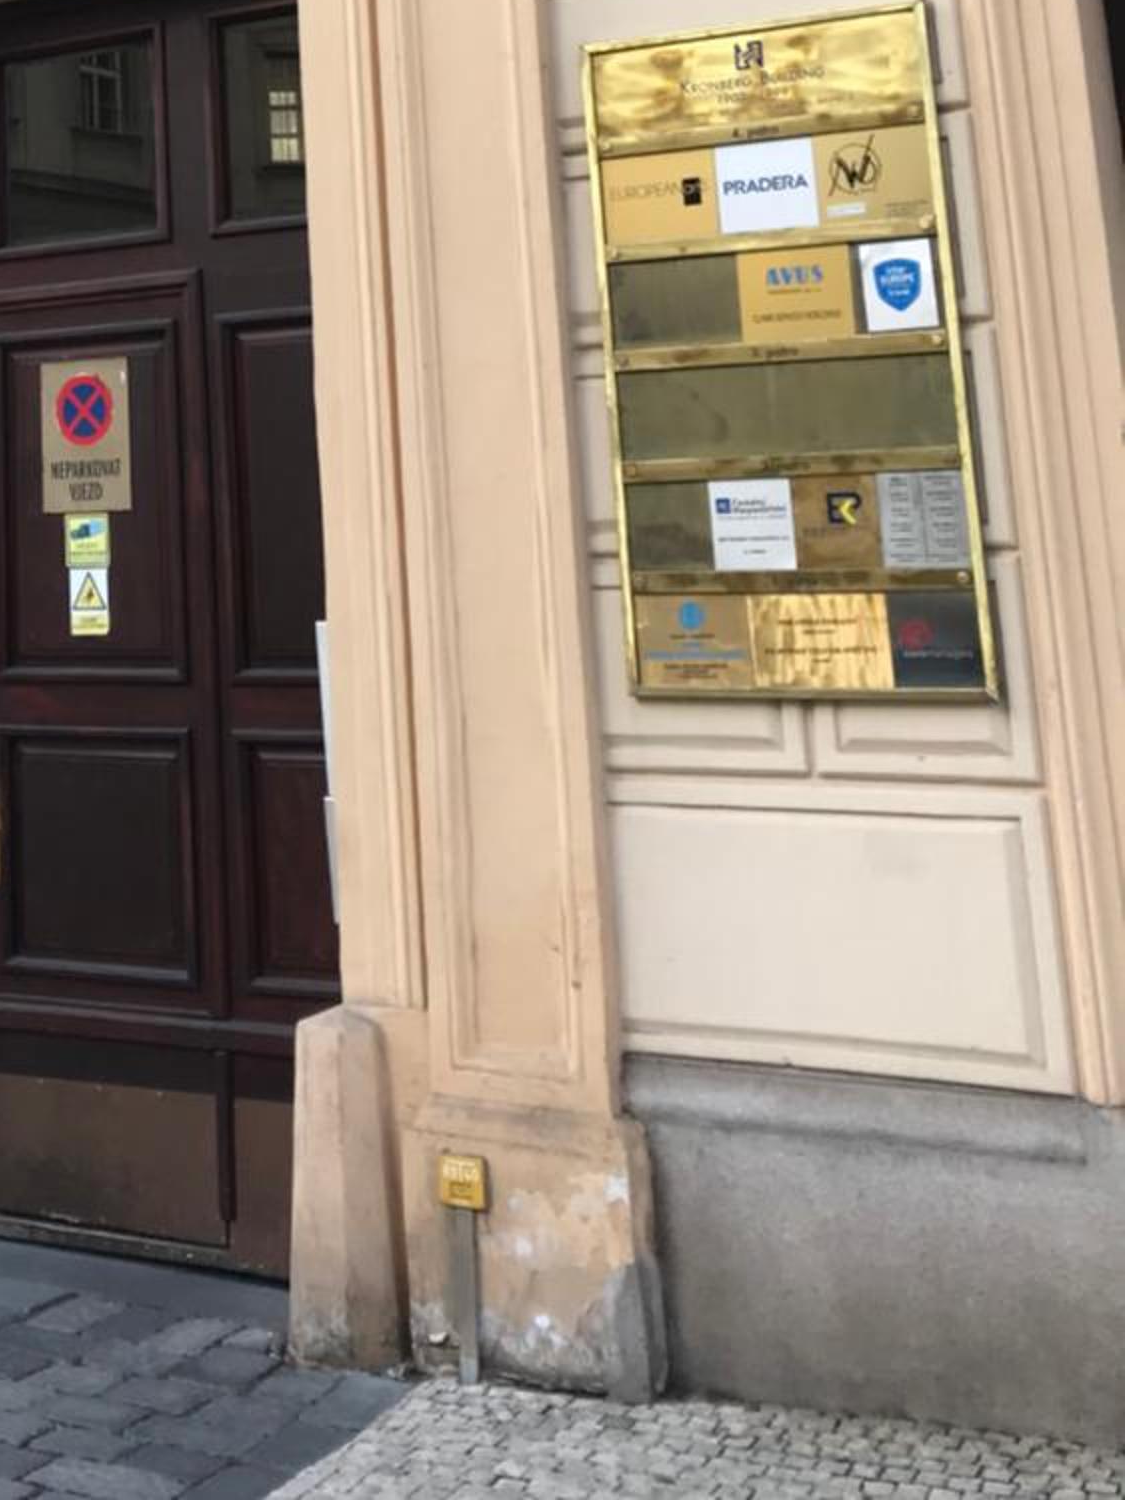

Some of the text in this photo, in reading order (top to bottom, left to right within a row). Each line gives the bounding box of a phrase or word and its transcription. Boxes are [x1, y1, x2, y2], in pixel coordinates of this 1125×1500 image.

[722, 173, 809, 195] PRADERA
[766, 264, 823, 286] AVUS
[50, 457, 121, 479] NEPARKOVAT
[68, 481, 103, 501] VJEZD
